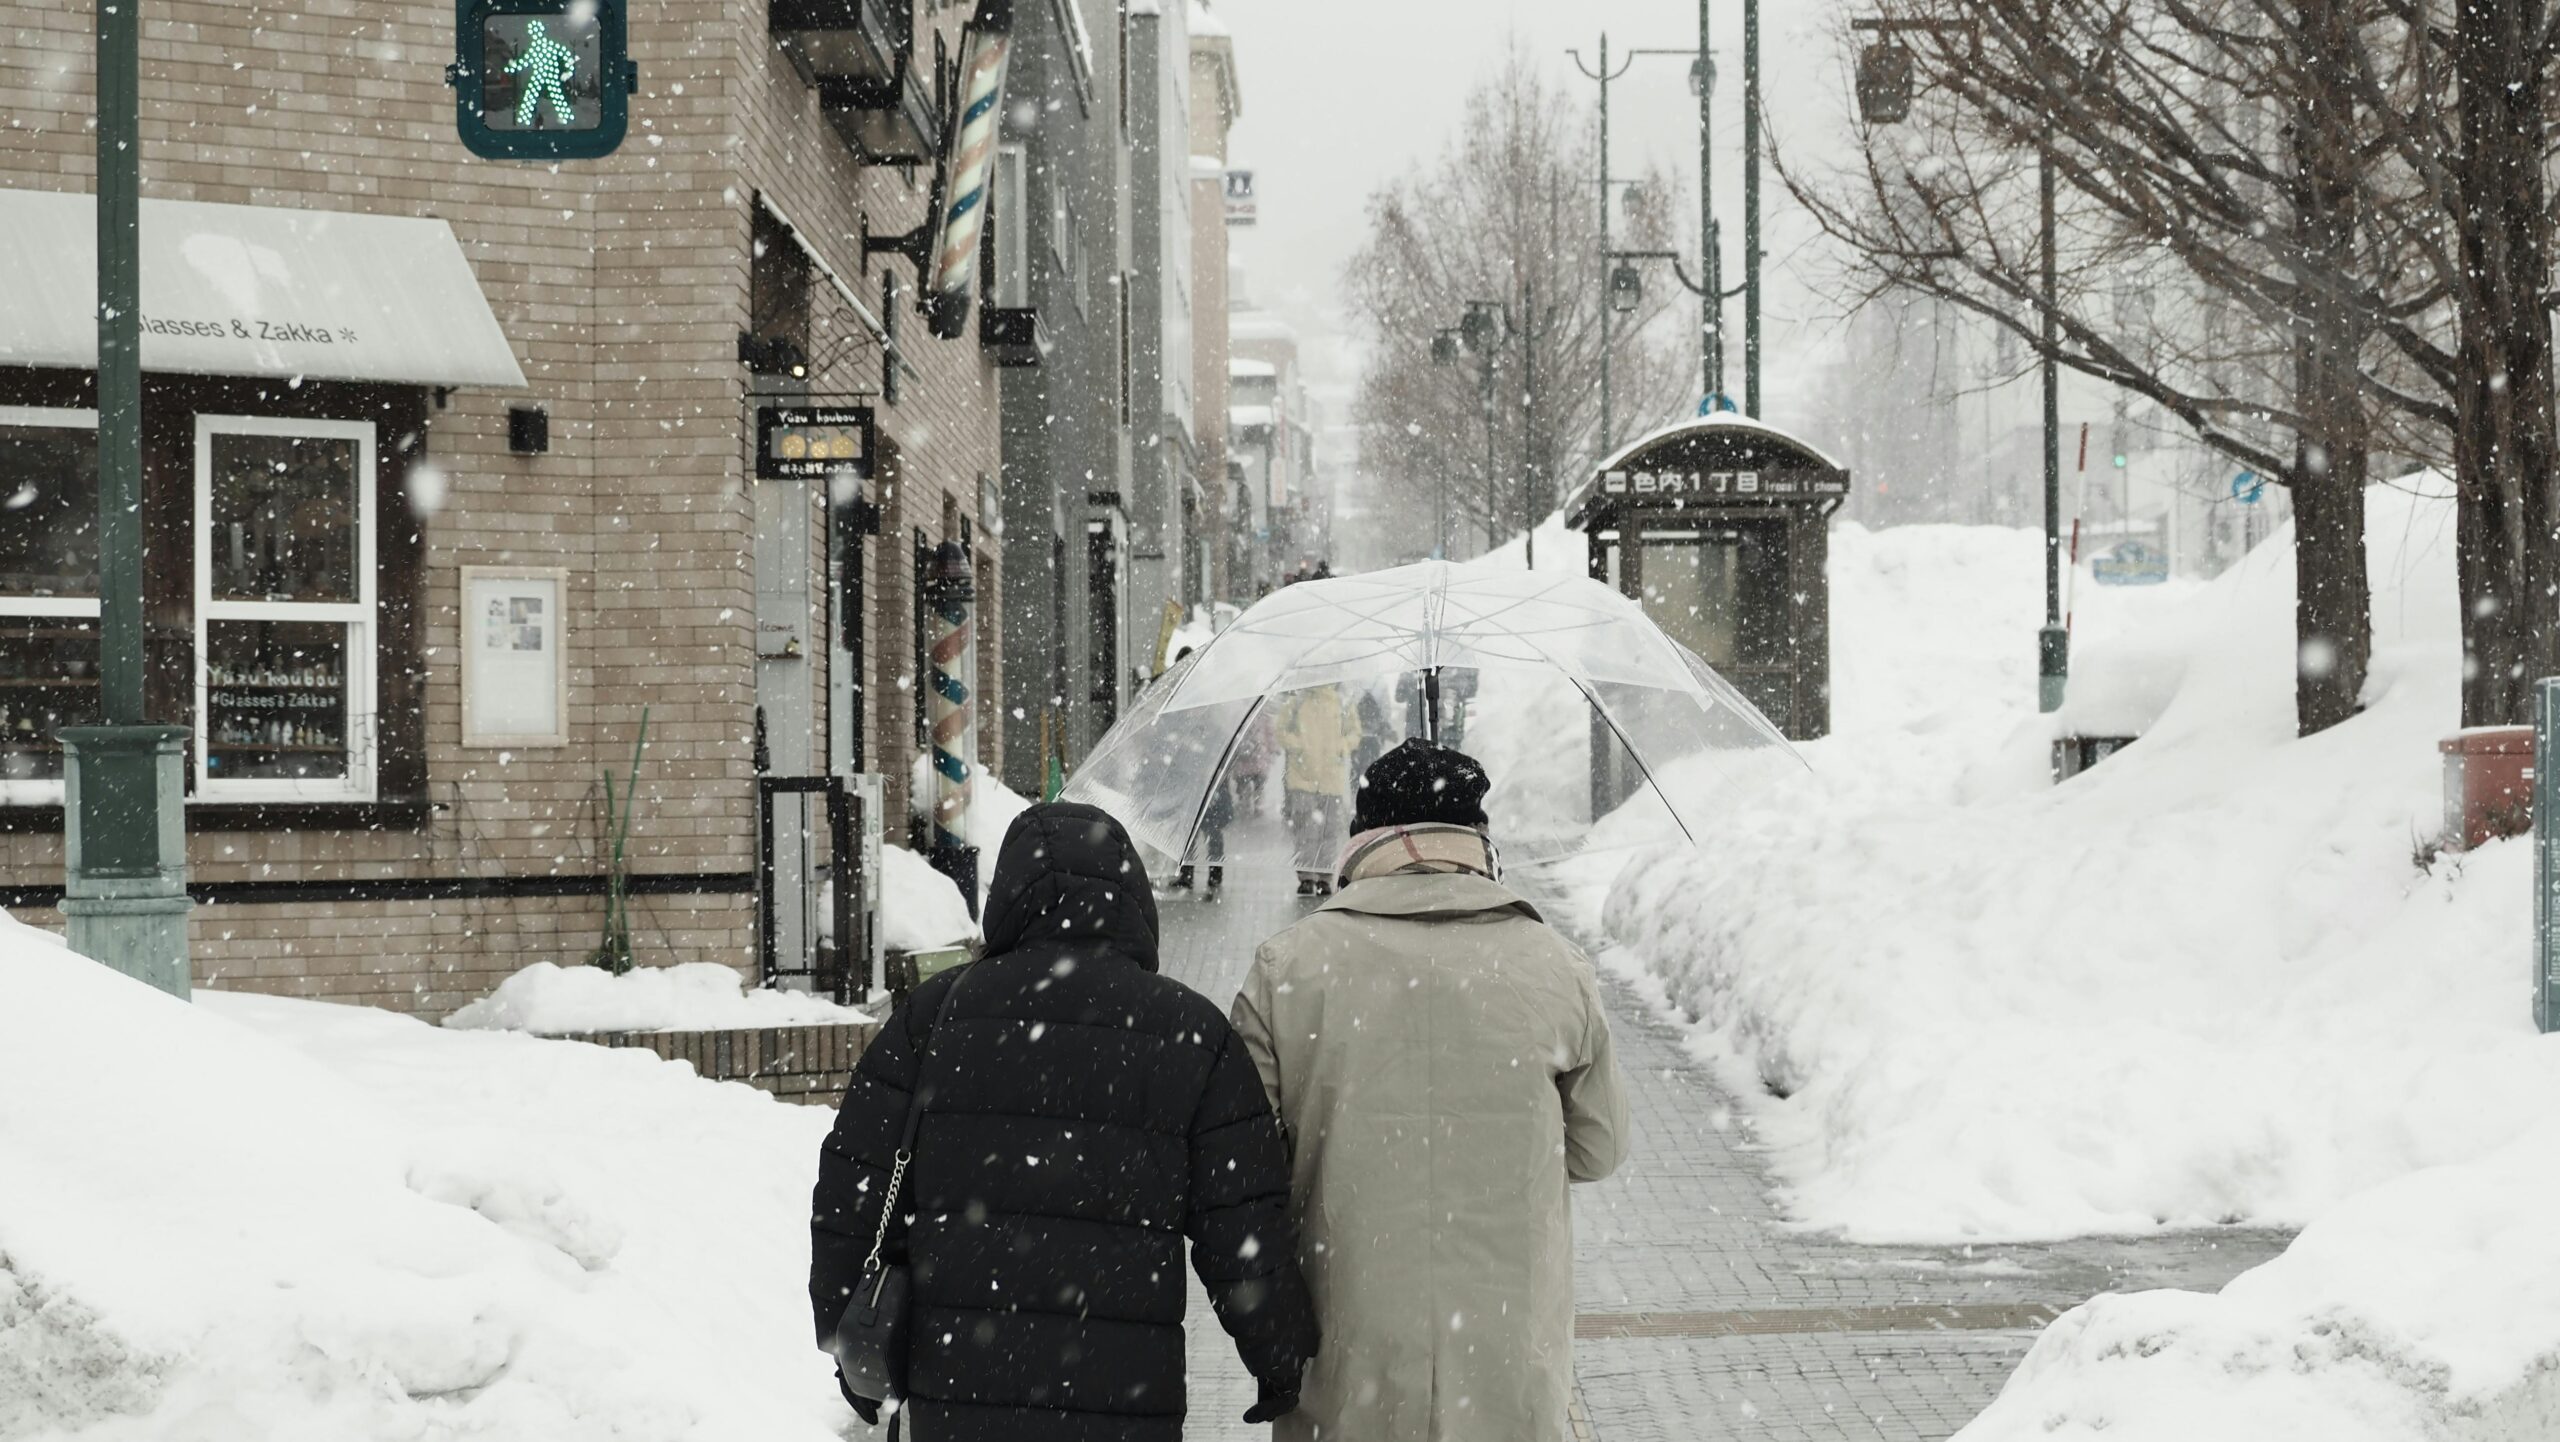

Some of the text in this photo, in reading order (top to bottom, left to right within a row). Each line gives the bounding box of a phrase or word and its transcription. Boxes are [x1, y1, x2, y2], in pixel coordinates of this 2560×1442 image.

[230, 318, 251, 340] &
[255, 320, 334, 344] Zakka
[778, 409, 856, 424] Yuzu koubou
[757, 620, 795, 633] lcome
[206, 664, 339, 687] Yuzu koubou
